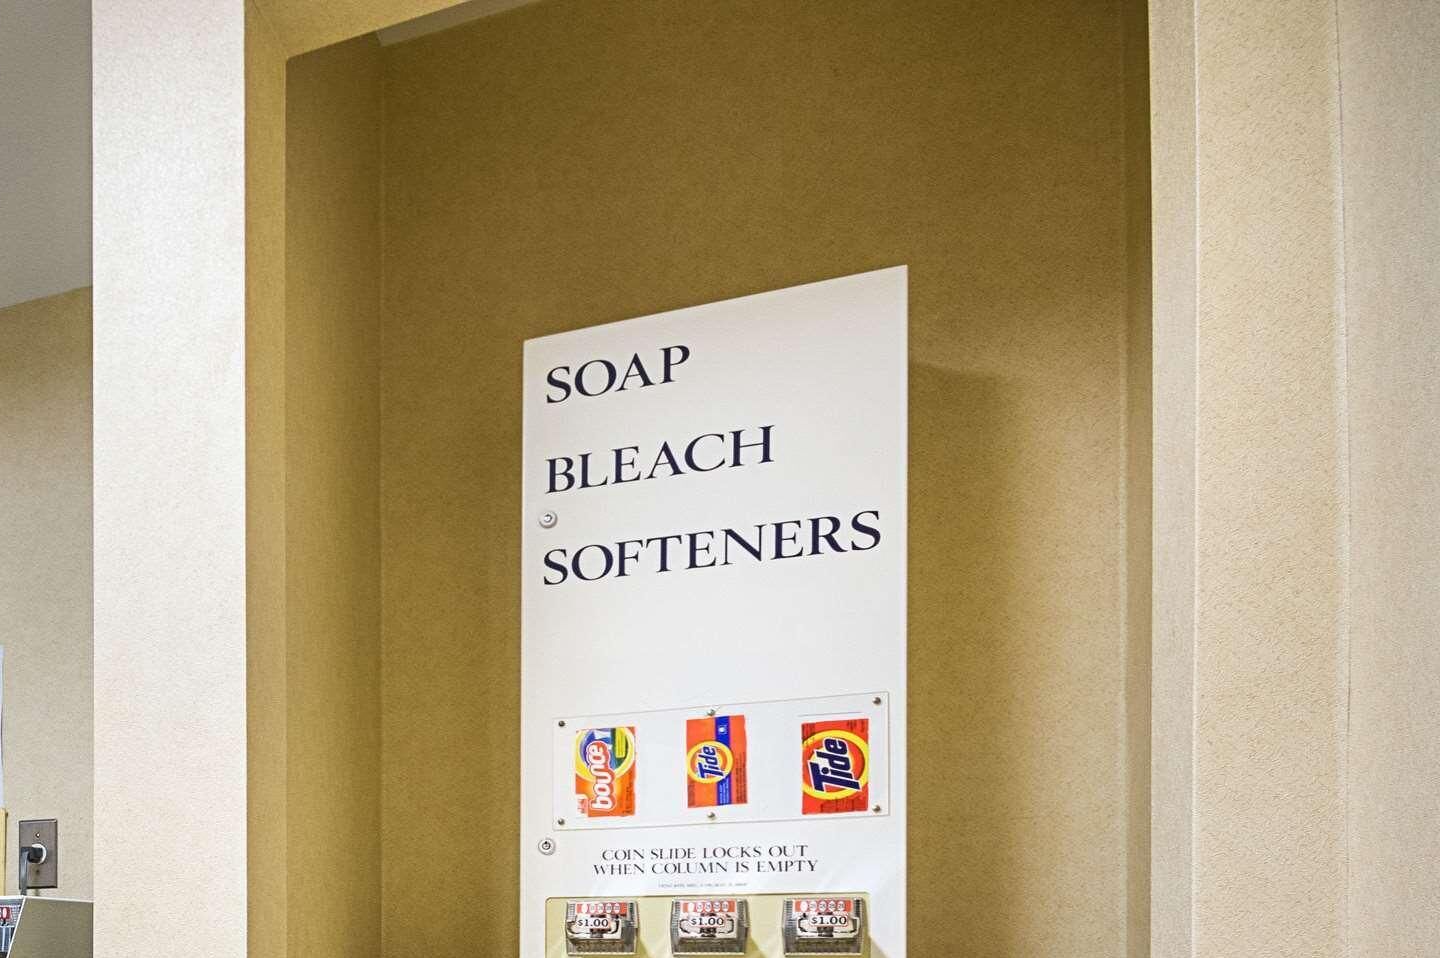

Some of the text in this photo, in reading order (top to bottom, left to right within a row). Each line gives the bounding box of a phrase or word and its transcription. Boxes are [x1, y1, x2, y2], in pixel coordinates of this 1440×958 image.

[546, 344, 691, 404] SOAP
[545, 424, 775, 494] BLEACH
[543, 510, 881, 586] SOFTENERS
[587, 741, 615, 810] bounce
[697, 745, 724, 779] Tide
[808, 738, 861, 792] Tide
[593, 860, 818, 875] WHEN COLUMN IS EMPTY
[601, 845, 809, 861] COIN SLIDE LOCKS OUT
[577, 918, 609, 927] $1.00
[691, 917, 724, 926] $1.00
[811, 916, 847, 925] $1.00
